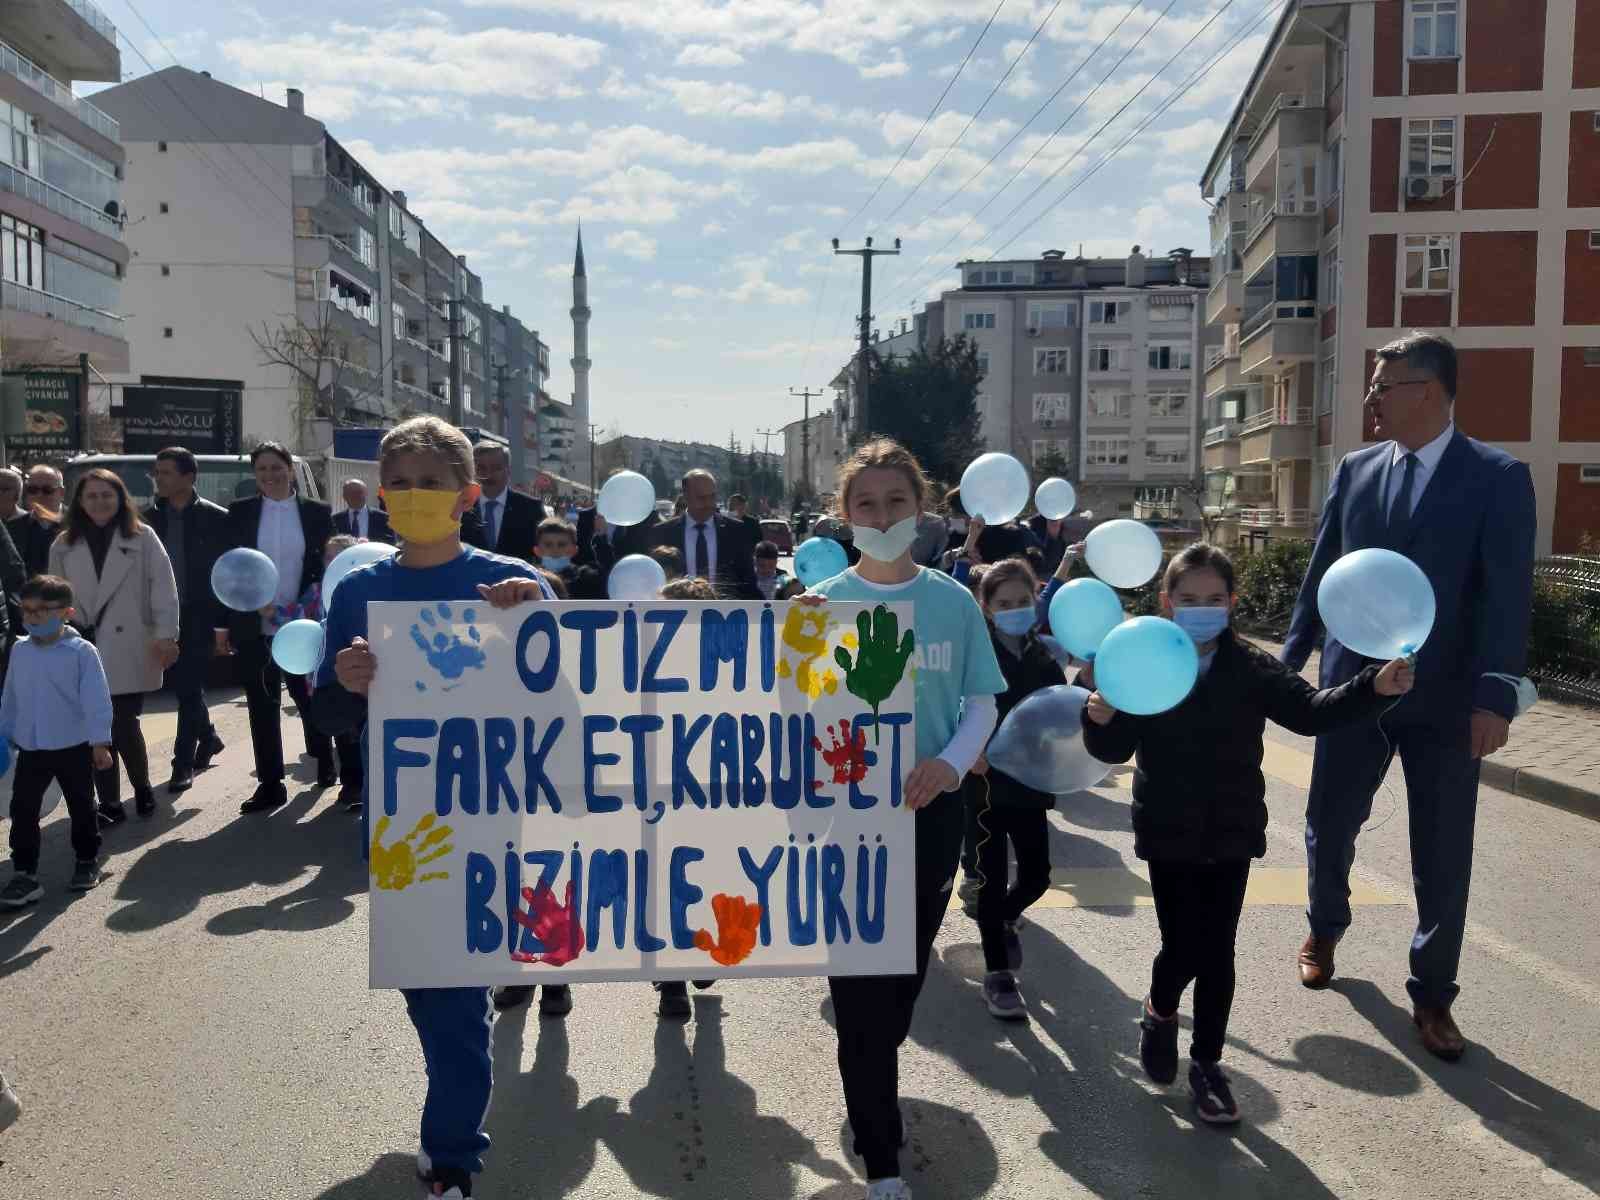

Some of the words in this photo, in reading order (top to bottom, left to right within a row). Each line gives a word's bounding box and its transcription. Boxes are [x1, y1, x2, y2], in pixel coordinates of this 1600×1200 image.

[382, 716, 565, 817] FARK
[466, 840, 706, 955] BİZİMLE
[738, 832, 889, 947] YÜRÜ
